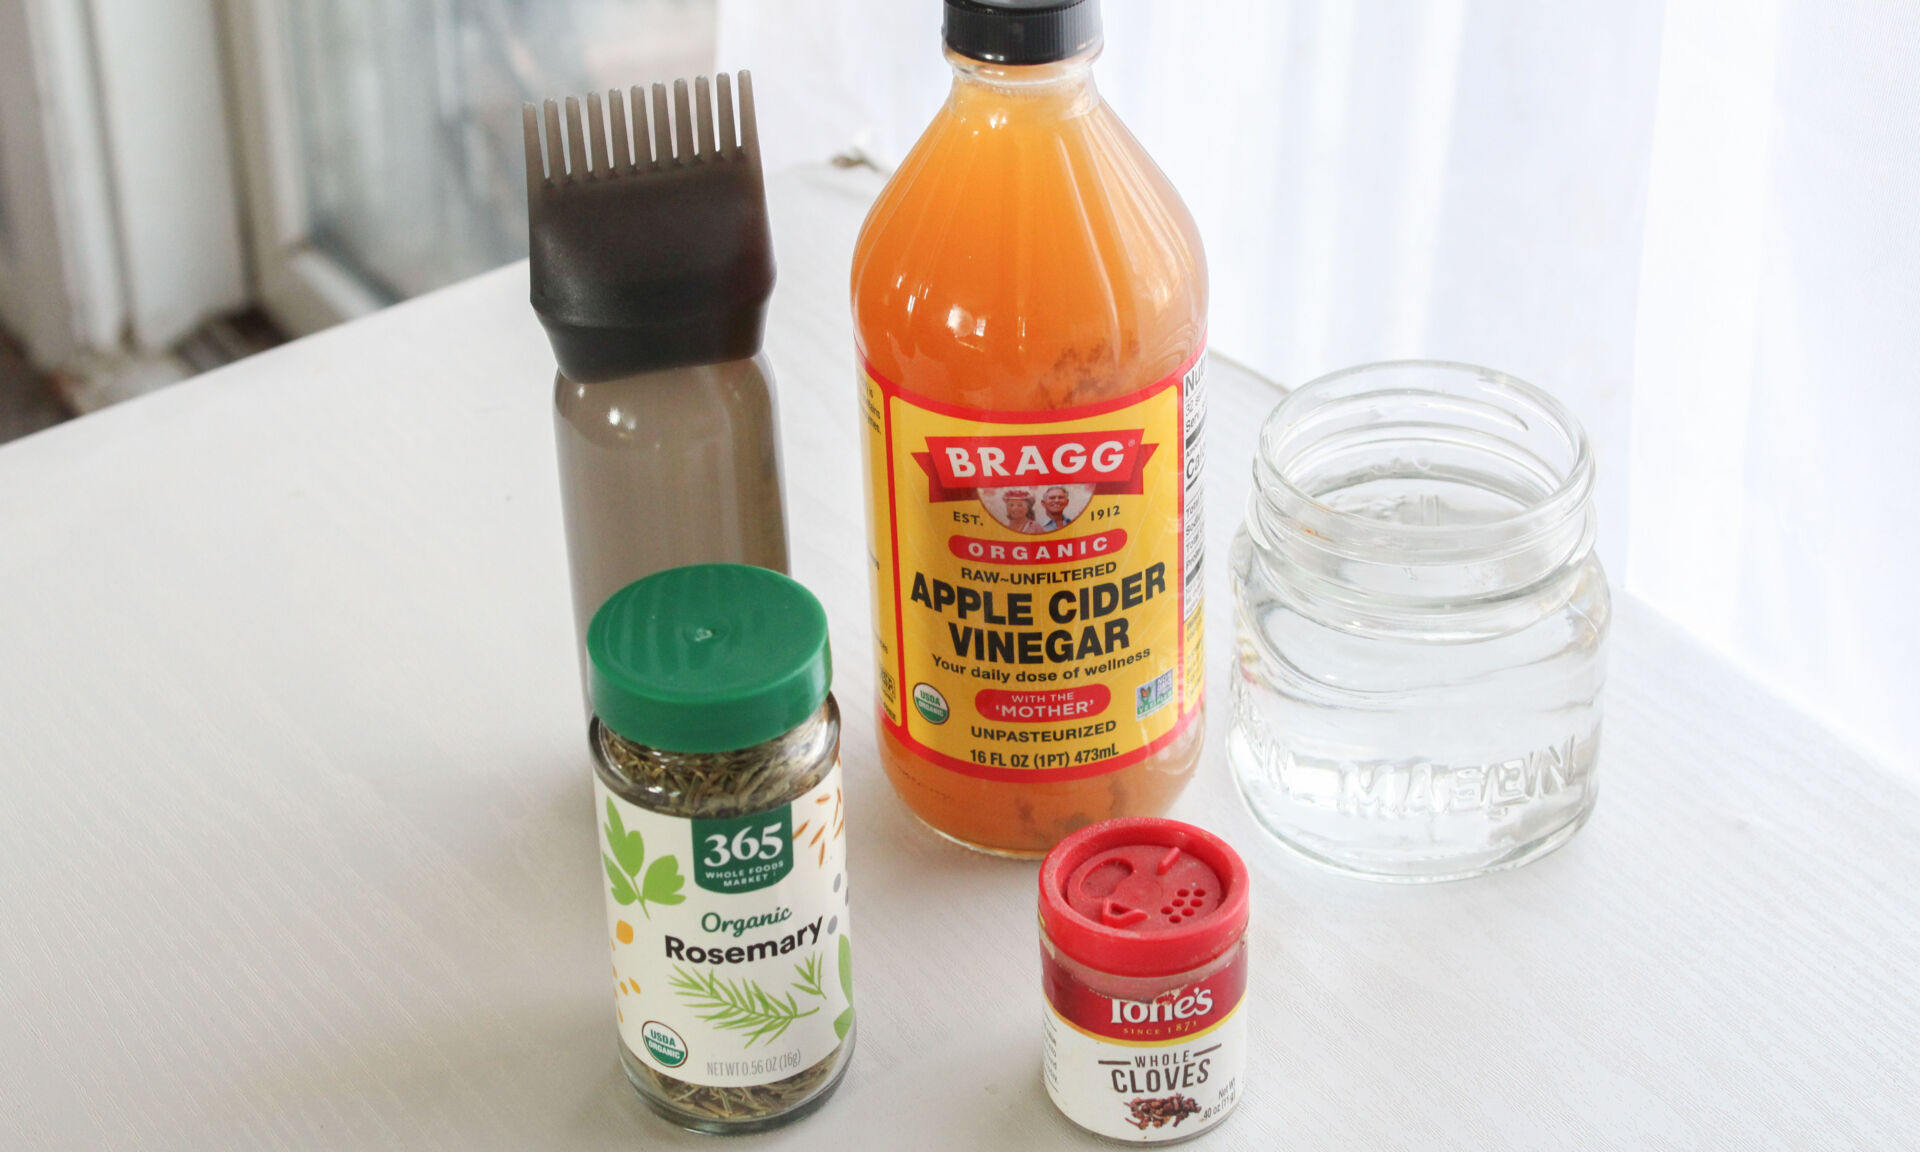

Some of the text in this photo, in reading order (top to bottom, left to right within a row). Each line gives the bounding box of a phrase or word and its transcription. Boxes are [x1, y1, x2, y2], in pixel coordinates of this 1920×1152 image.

[945, 440, 1125, 478] BRAGG
[953, 505, 1121, 527] EST. 1912
[968, 536, 1108, 561] ORGANIC
[911, 572, 1033, 626] APPLE
[1049, 562, 1166, 624] CIDER
[948, 618, 1130, 664] VINEGAR
[932, 648, 1151, 684] Your daily dose of wellness
[917, 698, 945, 718] ORGANIC
[919, 689, 941, 706] USDA
[1011, 692, 1075, 703] WITH THE
[971, 720, 1117, 743] UNPASTEURIZED
[971, 743, 1119, 769] 16 FL OZ (1PT) 473mL
[703, 822, 783, 868] 365
[705, 861, 784, 879] WHOLE FOODS
[723, 874, 768, 887] MARKET
[701, 906, 793, 938] Organic
[665, 915, 823, 966] Rosemary
[650, 1029, 676, 1048] USDA
[1123, 1027, 1160, 1035] SINCE
[648, 1040, 681, 1060] ORGANIC
[1135, 1050, 1190, 1068] WHOLE
[706, 1048, 801, 1077] NET WT 0.56 OZ (16g)
[1111, 1058, 1211, 1094] CLOVES
